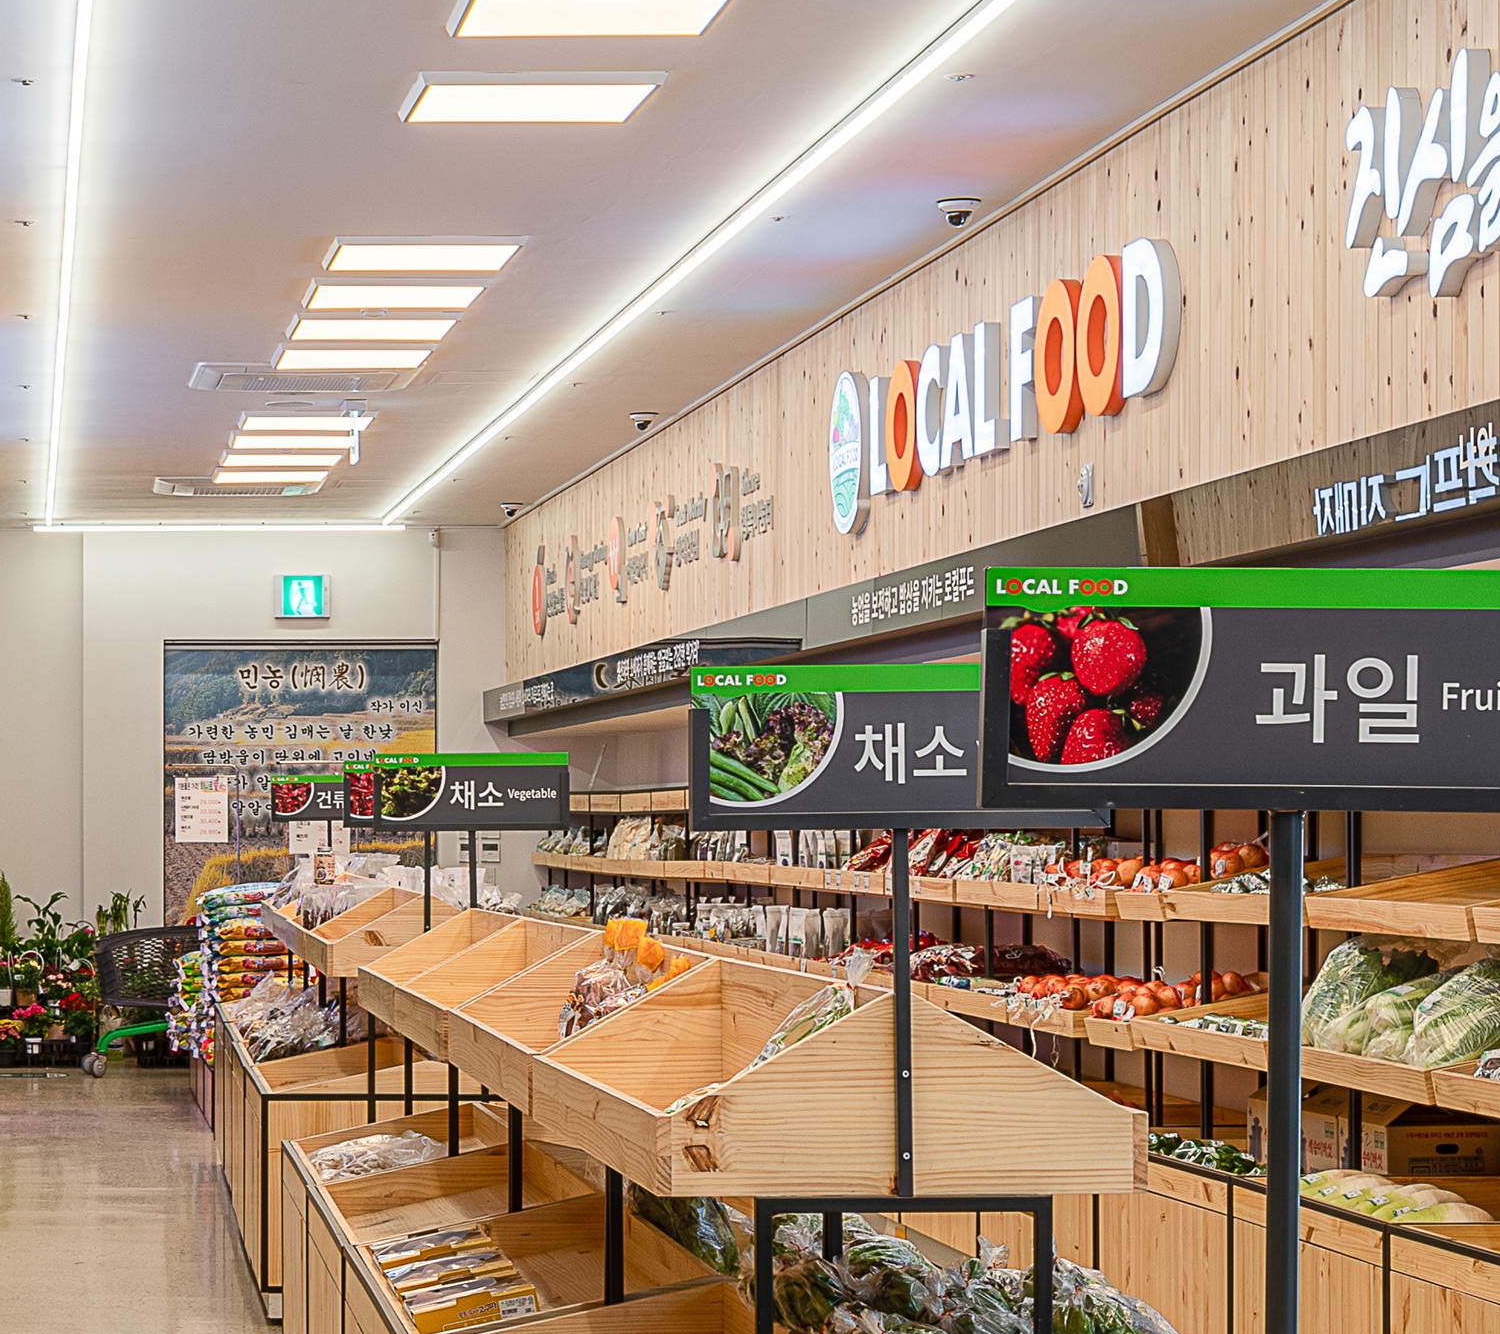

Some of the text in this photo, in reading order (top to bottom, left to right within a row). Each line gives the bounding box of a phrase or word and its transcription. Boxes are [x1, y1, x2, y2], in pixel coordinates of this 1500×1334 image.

[869, 237, 1172, 496] LOCAL FOOD
[996, 578, 1129, 596] LOCAL FOOD
[851, 566, 975, 626] 농업을 보전하고 밥상을 지키는 로컬푸드
[697, 673, 787, 687] LOCAL FOOD
[369, 699, 423, 714] 작가 이신
[1256, 653, 1422, 745] 과일
[188, 723, 394, 740] 가련한 농민 김매는 날 한낮
[203, 749, 265, 765] 땀방울이
[853, 722, 969, 784] 채소
[449, 780, 505, 811] 채소
[507, 787, 557, 802] Vegetable
[231, 800, 271, 817] 알알
